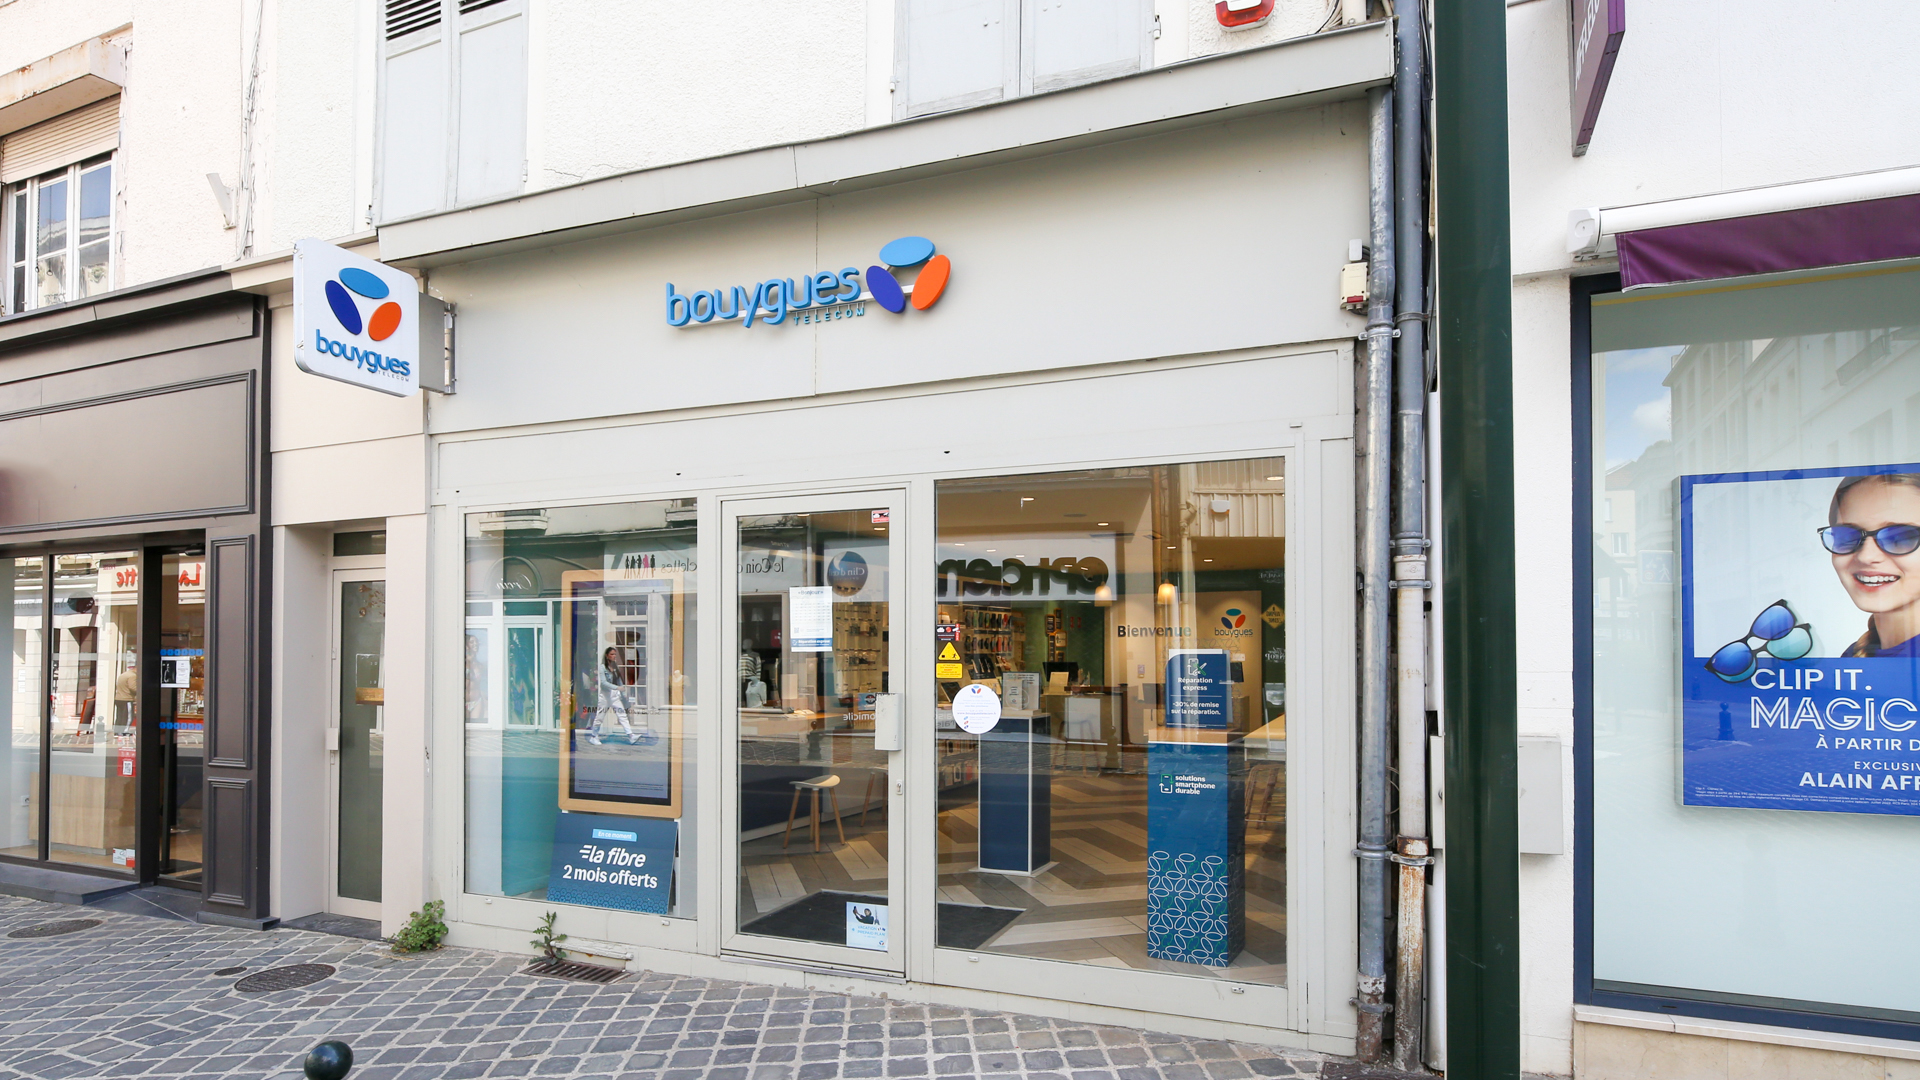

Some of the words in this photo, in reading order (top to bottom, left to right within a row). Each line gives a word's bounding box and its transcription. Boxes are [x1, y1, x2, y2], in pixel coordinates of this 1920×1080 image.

[666, 266, 862, 329] bouygues
[793, 307, 866, 326] TELECOM
[316, 329, 411, 376] bouygues
[378, 370, 410, 382] TELECOM
[1118, 625, 1192, 638] Bienvenue
[1214, 627, 1254, 638] bouygues
[1178, 676, 1213, 684] Réparation
[1751, 668, 1824, 690] CLIP
[1835, 668, 1872, 691] IT.
[1188, 708, 1221, 716] réparation.
[1751, 696, 1918, 732] MAGIC
[1816, 734, 1829, 749] À
[1835, 737, 1902, 751] PARTIR
[1175, 782, 1216, 790] smartphone
[1799, 771, 1873, 789] ALAIN
[611, 832, 632, 840] moment
[589, 845, 605, 864] la
[606, 847, 646, 868] fibre
[562, 864, 573, 879] 2
[574, 866, 608, 883] mois
[608, 869, 658, 889] offerts
